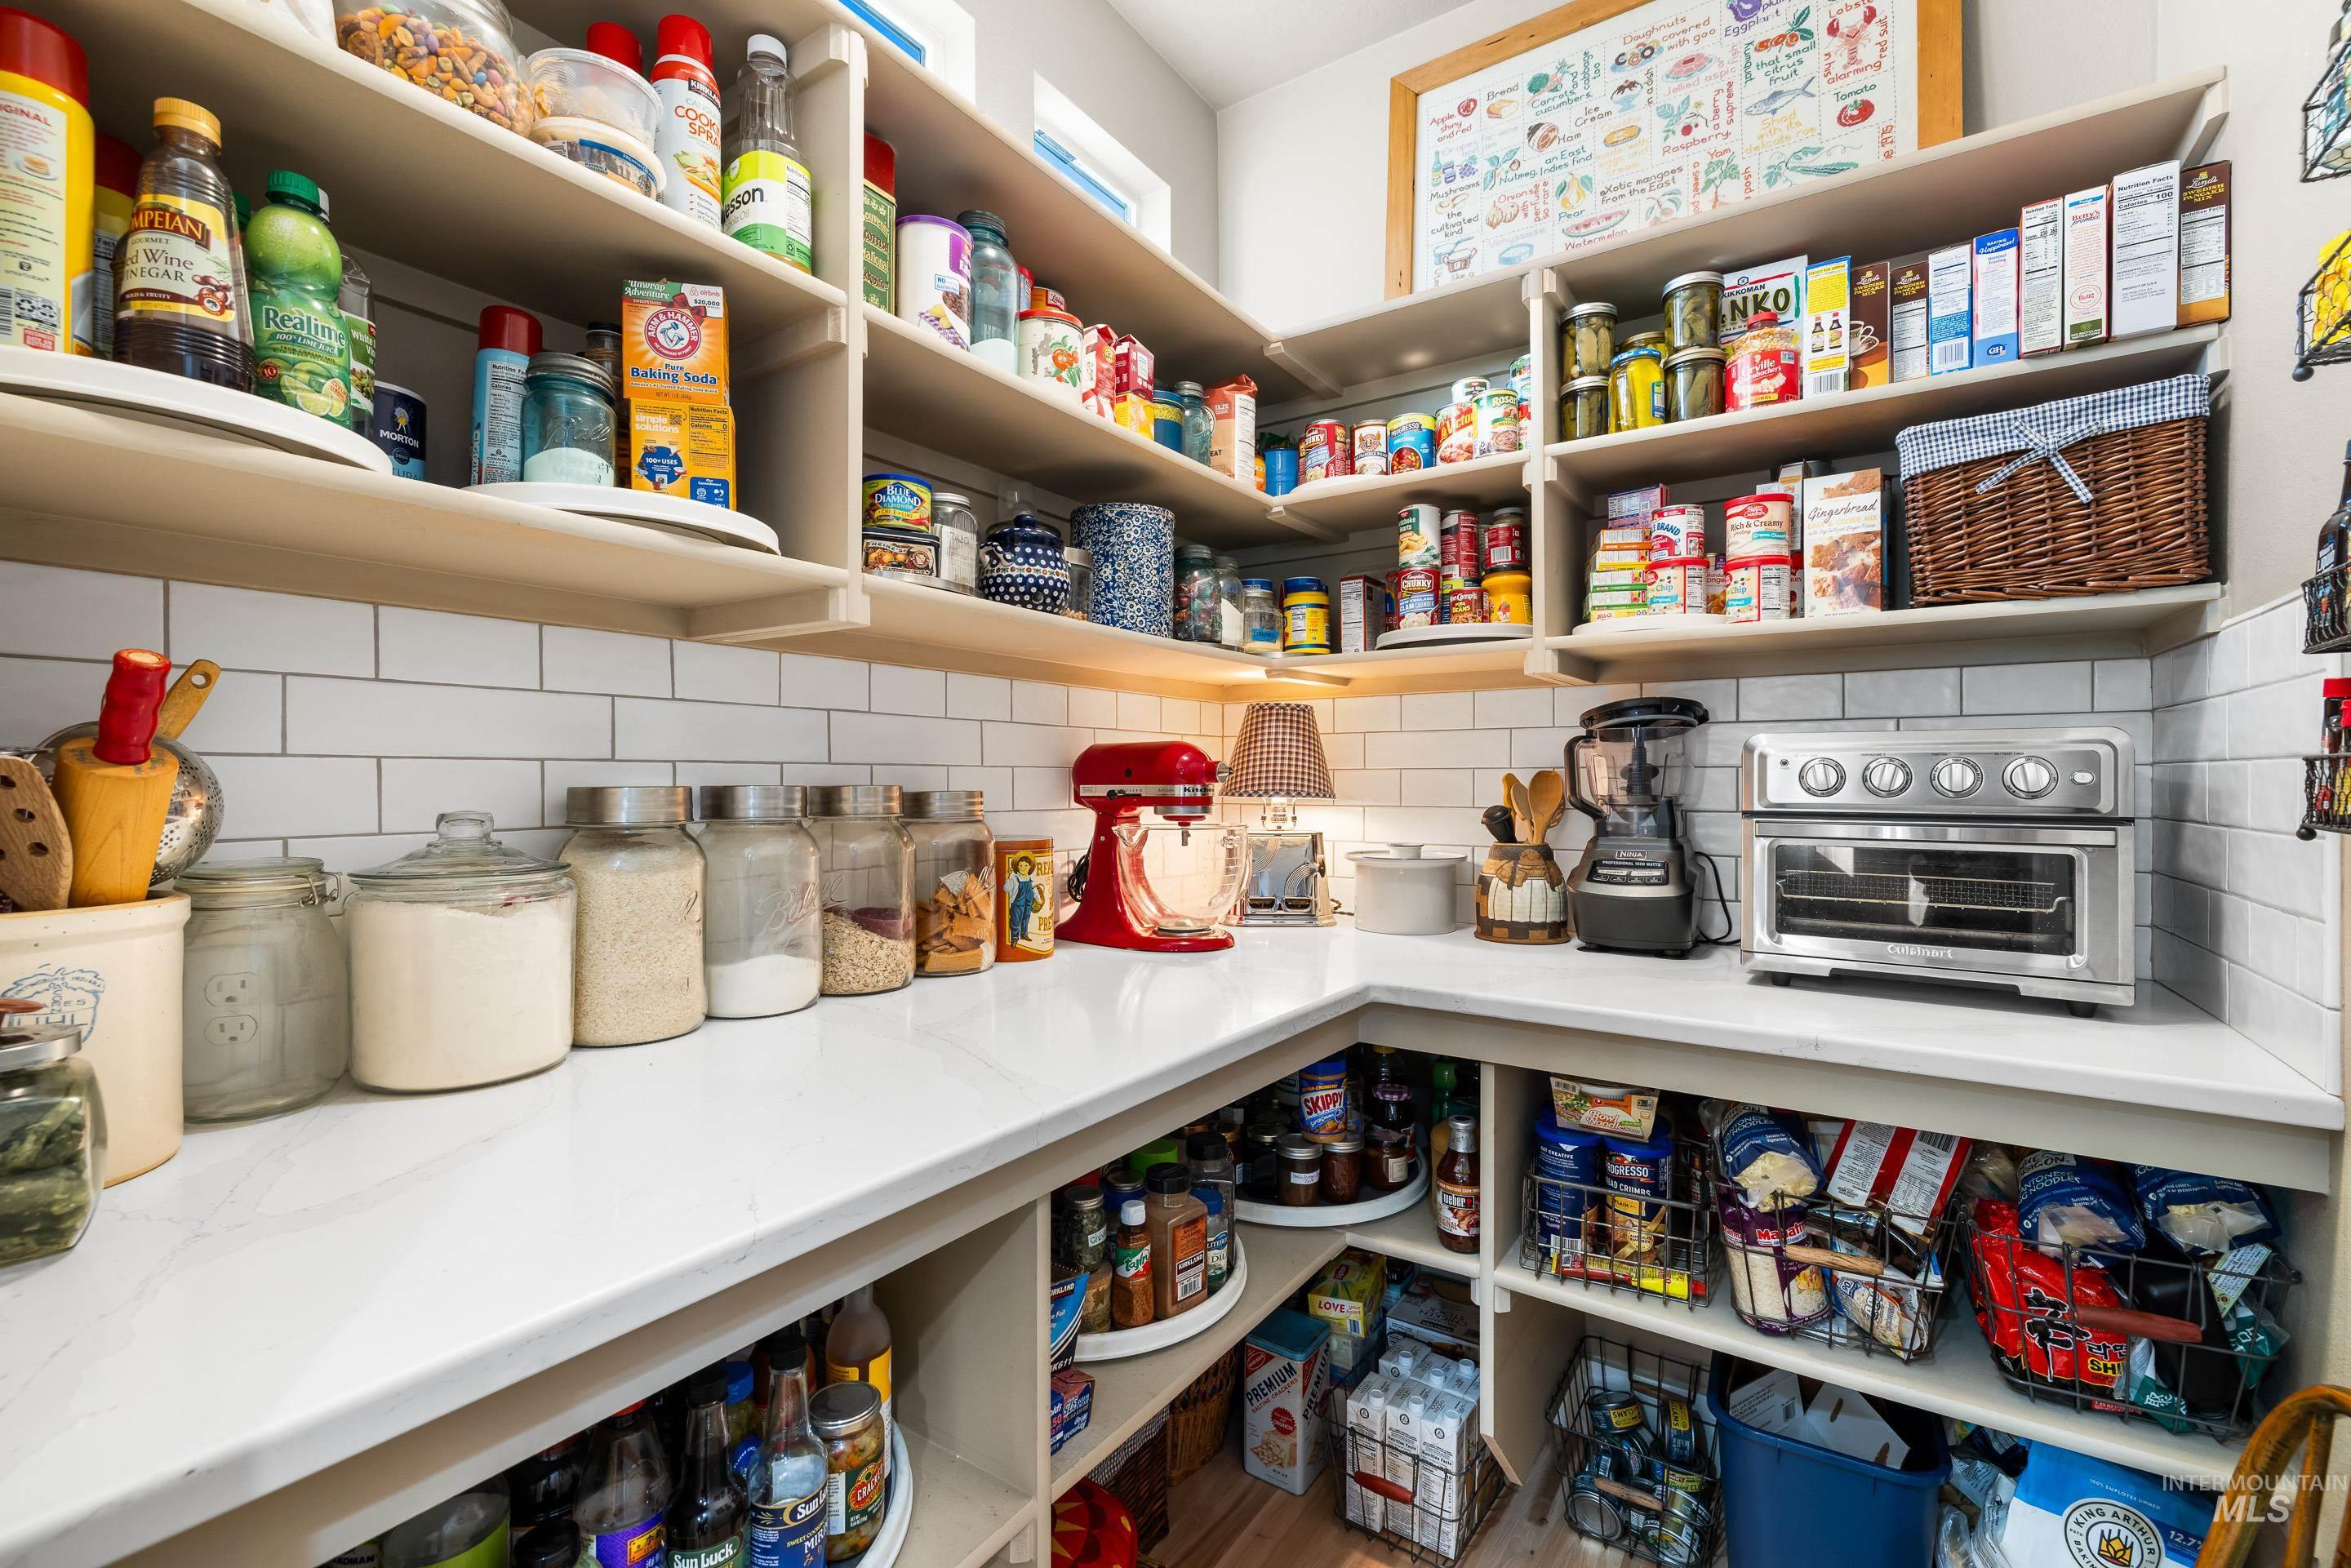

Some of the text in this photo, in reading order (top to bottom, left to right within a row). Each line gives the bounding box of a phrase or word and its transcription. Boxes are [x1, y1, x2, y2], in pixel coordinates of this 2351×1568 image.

[1623, 16, 1687, 45] Doughnuts
[1662, 16, 1710, 42] covered
[1724, 11, 1780, 37] Eggplant
[1667, 29, 1715, 51] with goo
[1875, 16, 1888, 59] red suit
[1756, 40, 1815, 70] that small
[1581, 51, 1593, 90] cabbage
[1592, 62, 1600, 80] too
[1764, 57, 1803, 77] citrus
[1827, 60, 1882, 85] alarming
[1769, 69, 1798, 86] fruit
[1487, 82, 1519, 101] Bread
[1833, 83, 1877, 102] Tomato
[1711, 88, 1724, 121] berry
[1727, 81, 1737, 125] supreme
[1575, 110, 1612, 127] Cream
[1584, 106, 1600, 116] Ice
[1441, 121, 1462, 133] shiny
[1455, 124, 1472, 136] red
[1557, 132, 1581, 145] Ham
[1545, 144, 1587, 164] an East
[1707, 148, 1731, 160] Yam
[1540, 162, 1569, 175] Indies
[1636, 165, 1684, 186] mangoes
[1430, 180, 1480, 201] Mushrooms
[1602, 176, 1677, 205] from the East
[2118, 175, 2173, 192] Nutrition Facts
[2182, 184, 2225, 196] SWEDISH
[2118, 192, 2173, 209] Calories 100
[2182, 189, 2225, 201] PANCAKE
[2193, 195, 2213, 203] MIX
[1447, 211, 1462, 219] the
[1558, 209, 1586, 221] Pear
[2025, 207, 2045, 215] Nutrition
[2072, 210, 2100, 221] Betty's
[2181, 210, 2207, 218] Nutrition
[1431, 214, 1479, 234] cultivated
[1444, 227, 1463, 238] kind
[1565, 229, 1628, 251] Watermelon
[131, 237, 170, 245] GOURMET
[1979, 238, 2015, 255] Happiness!
[143, 248, 193, 270] Wine
[126, 267, 186, 283] INEGAR
[1722, 283, 1766, 299] KIKKOMAN
[1854, 281, 1885, 291] SWEDISH
[1854, 286, 1885, 295] PANCAKE
[1894, 280, 1926, 291] SWEDISH
[1894, 286, 1926, 295] PANCAKE
[624, 287, 670, 300] Adventure
[694, 299, 720, 307] $20,000
[647, 311, 698, 342] ARM HAMMER
[298, 336, 338, 353] LIME JUICE
[492, 364, 516, 373] Nutrition
[664, 363, 685, 371] Pure
[630, 366, 717, 384] Baking Soda
[491, 383, 512, 391] Calories
[635, 413, 669, 425] simple
[635, 423, 680, 433] solutions
[1390, 422, 1420, 437] PROGRESSO
[380, 429, 420, 448] MORTON
[887, 486, 911, 497] BLUE
[874, 493, 921, 506] DIAMOND
[1748, 505, 1763, 513] Betty
[1807, 499, 1878, 524] Gingerbread
[1656, 522, 1681, 535] BRAND
[1731, 523, 1744, 531] Rich
[1753, 520, 1784, 530] Creamy
[1402, 579, 1432, 589] CHUNKY
[1655, 584, 1673, 593] Chip
[1731, 587, 1747, 595] Chip
[1399, 600, 1434, 611] CLAM CHOWDER
[1887, 944, 1953, 960] Cuisinart
[1303, 1090, 1344, 1117] SKIPPY
[1589, 1109, 1619, 1122] Bowl
[1587, 1117, 1624, 1130] Noodle
[1548, 1148, 1574, 1159] CREATIVE
[2035, 1176, 2081, 1195] NOODLES
[1443, 1193, 1466, 1207] weber
[1178, 1253, 1204, 1271] KIRKLAND
[1318, 1300, 1345, 1313] LOVE
[1247, 1353, 1265, 1370] NABISCO
[1246, 1361, 1297, 1406] PREMIUM
[1251, 1378, 1299, 1414] SALTINE CRACKERS
[1273, 1419, 1294, 1432] CRUNCH
[1421, 1450, 1452, 1466] Nutrition Facts
[2089, 1478, 2161, 1510] 100% EMPLOYEE OWNED
[2069, 1527, 2083, 1537] ESTD
[2073, 1508, 2156, 1557] KING ARTHUR
[786, 1535, 806, 1548] SWEET
[673, 1552, 698, 1568] Sun
